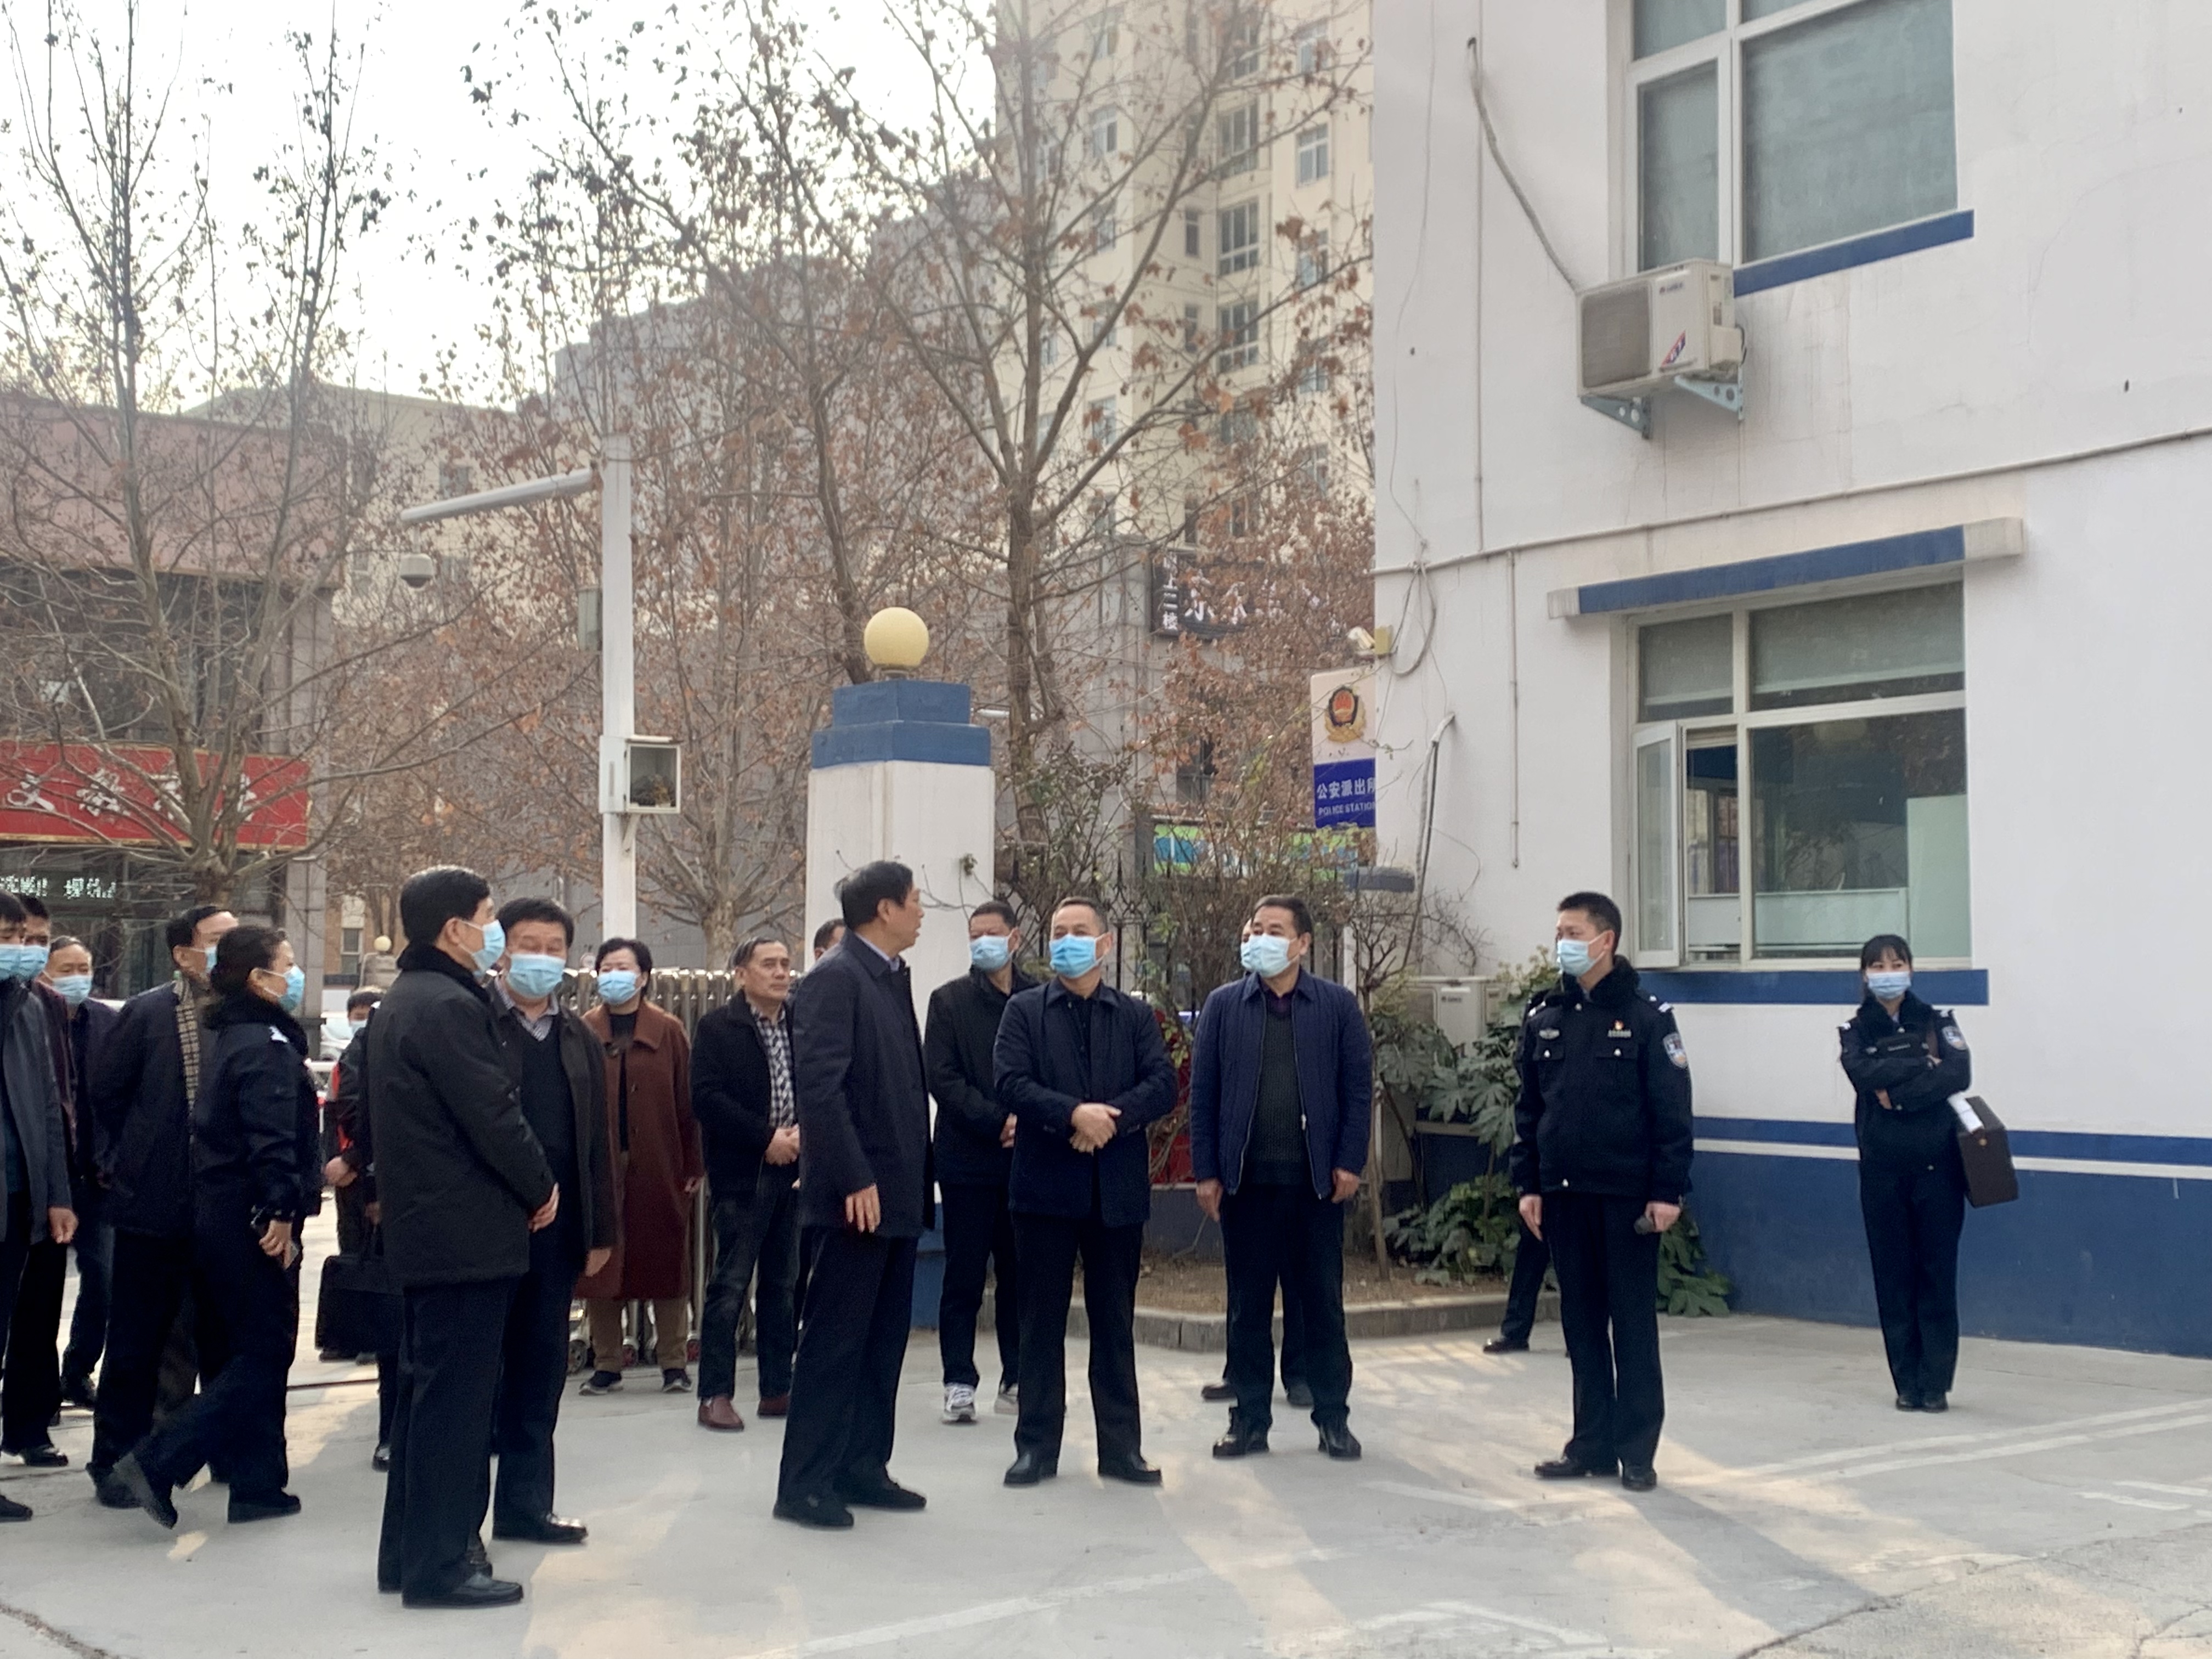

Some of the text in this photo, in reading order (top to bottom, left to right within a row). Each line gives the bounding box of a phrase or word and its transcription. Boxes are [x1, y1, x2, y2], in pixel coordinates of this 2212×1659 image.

[1317, 777, 1375, 799] 公安派出所
[1318, 804, 1344, 816] POLICE
